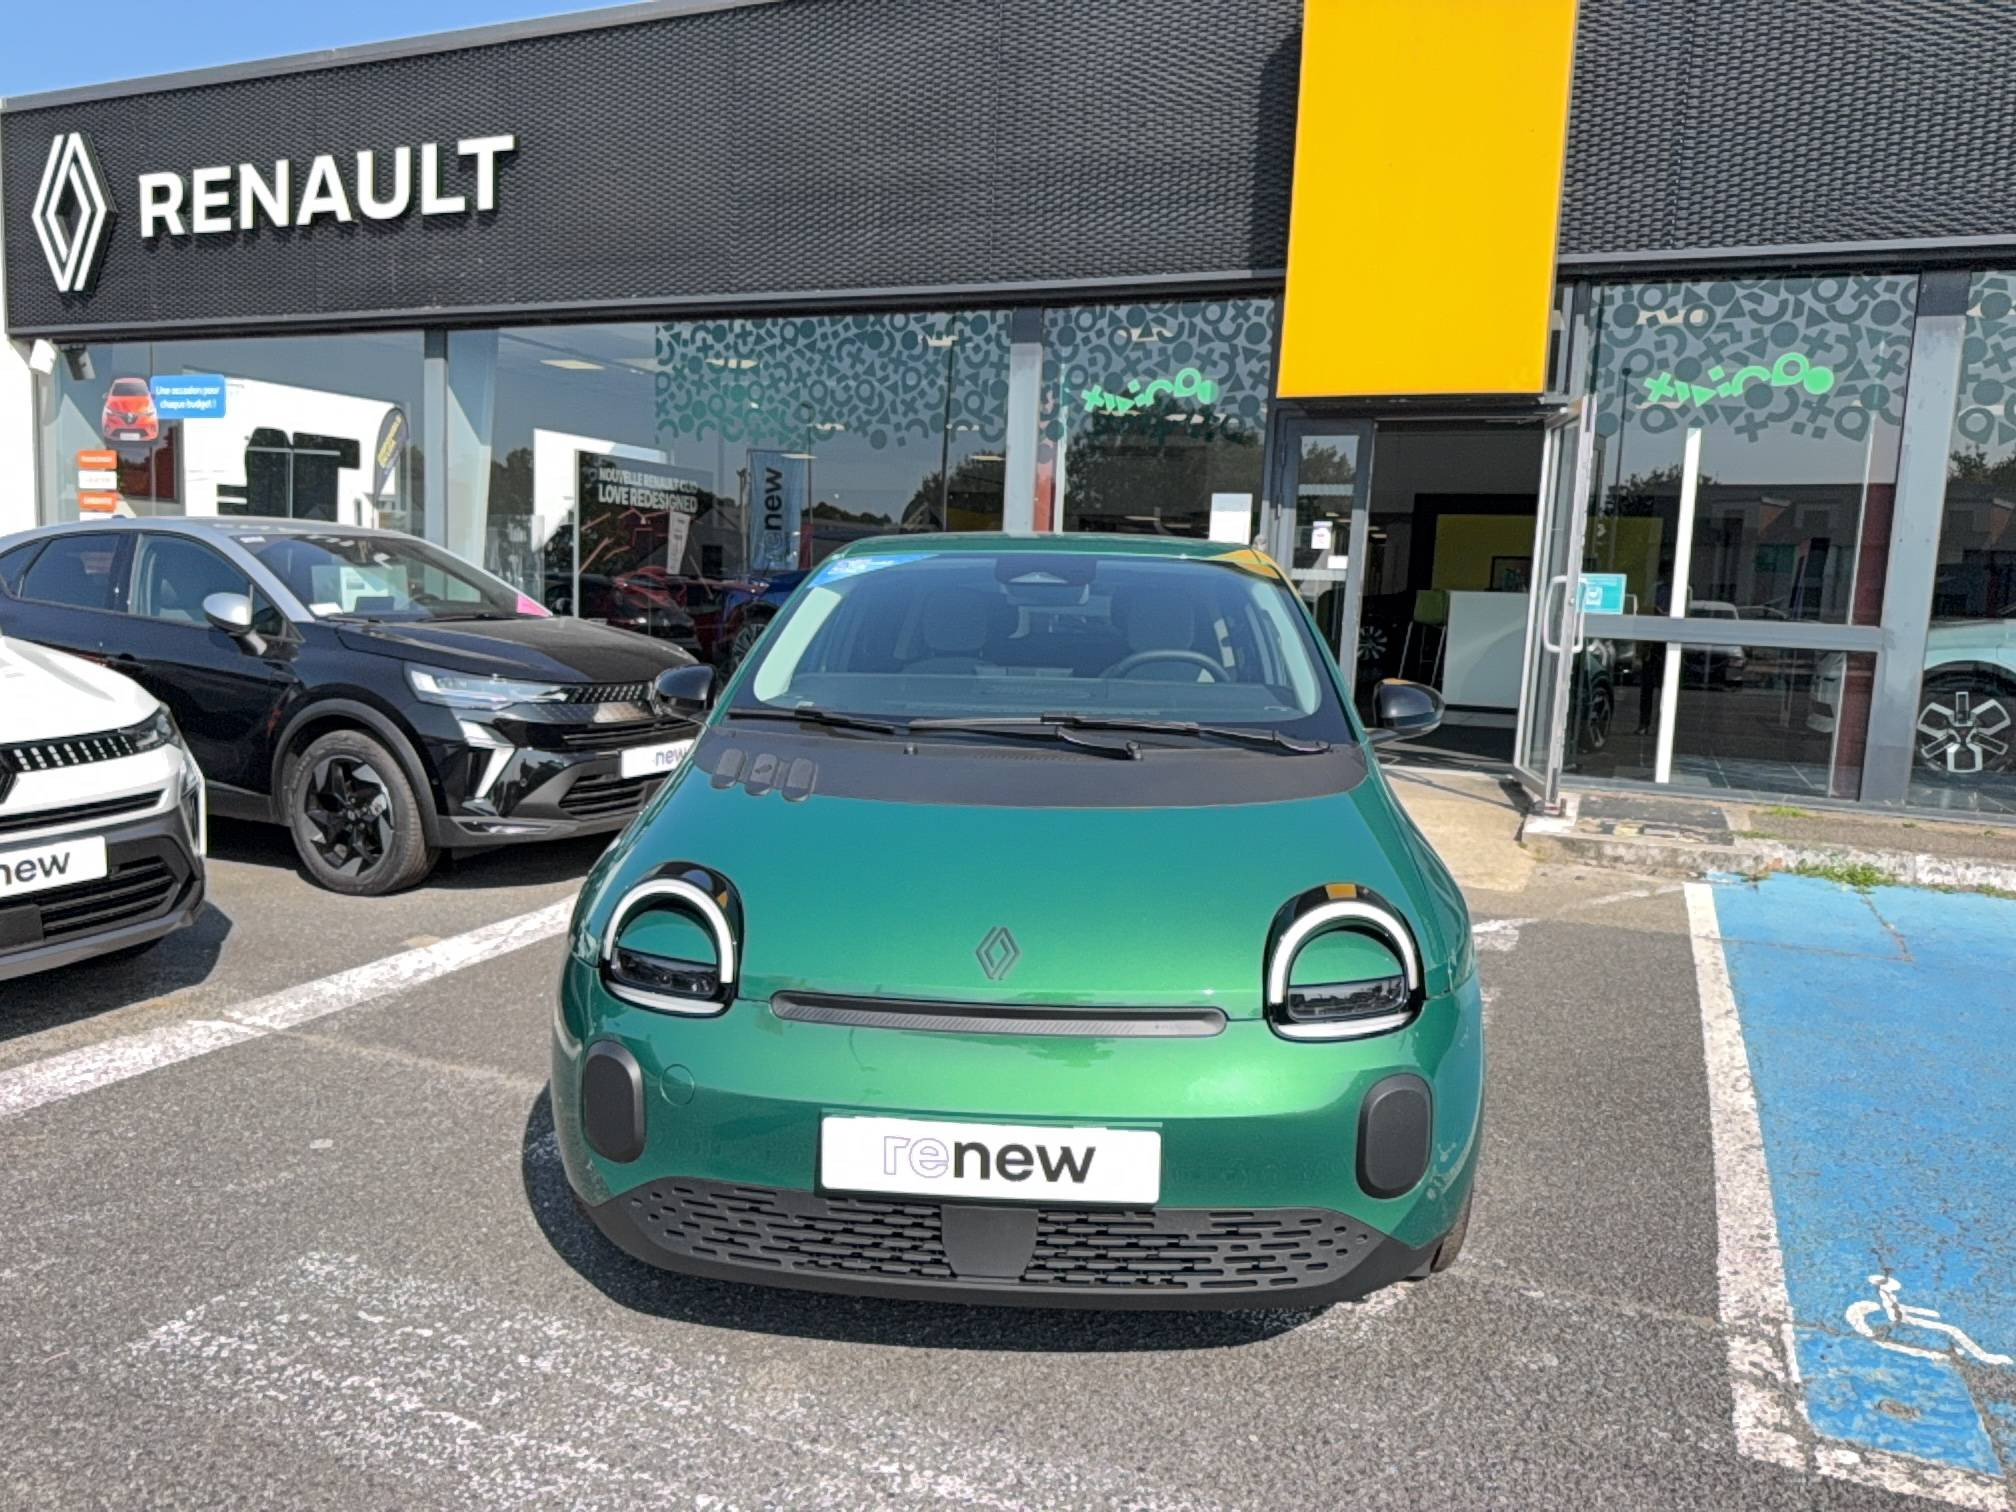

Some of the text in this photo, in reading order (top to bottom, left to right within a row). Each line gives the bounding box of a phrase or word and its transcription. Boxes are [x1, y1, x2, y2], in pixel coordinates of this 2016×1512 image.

[139, 134, 516, 238] RENAULT
[599, 467, 643, 486] NOUVELLE
[598, 484, 698, 513] LOVE REDESIGNED
[883, 1135, 1097, 1183] renew
